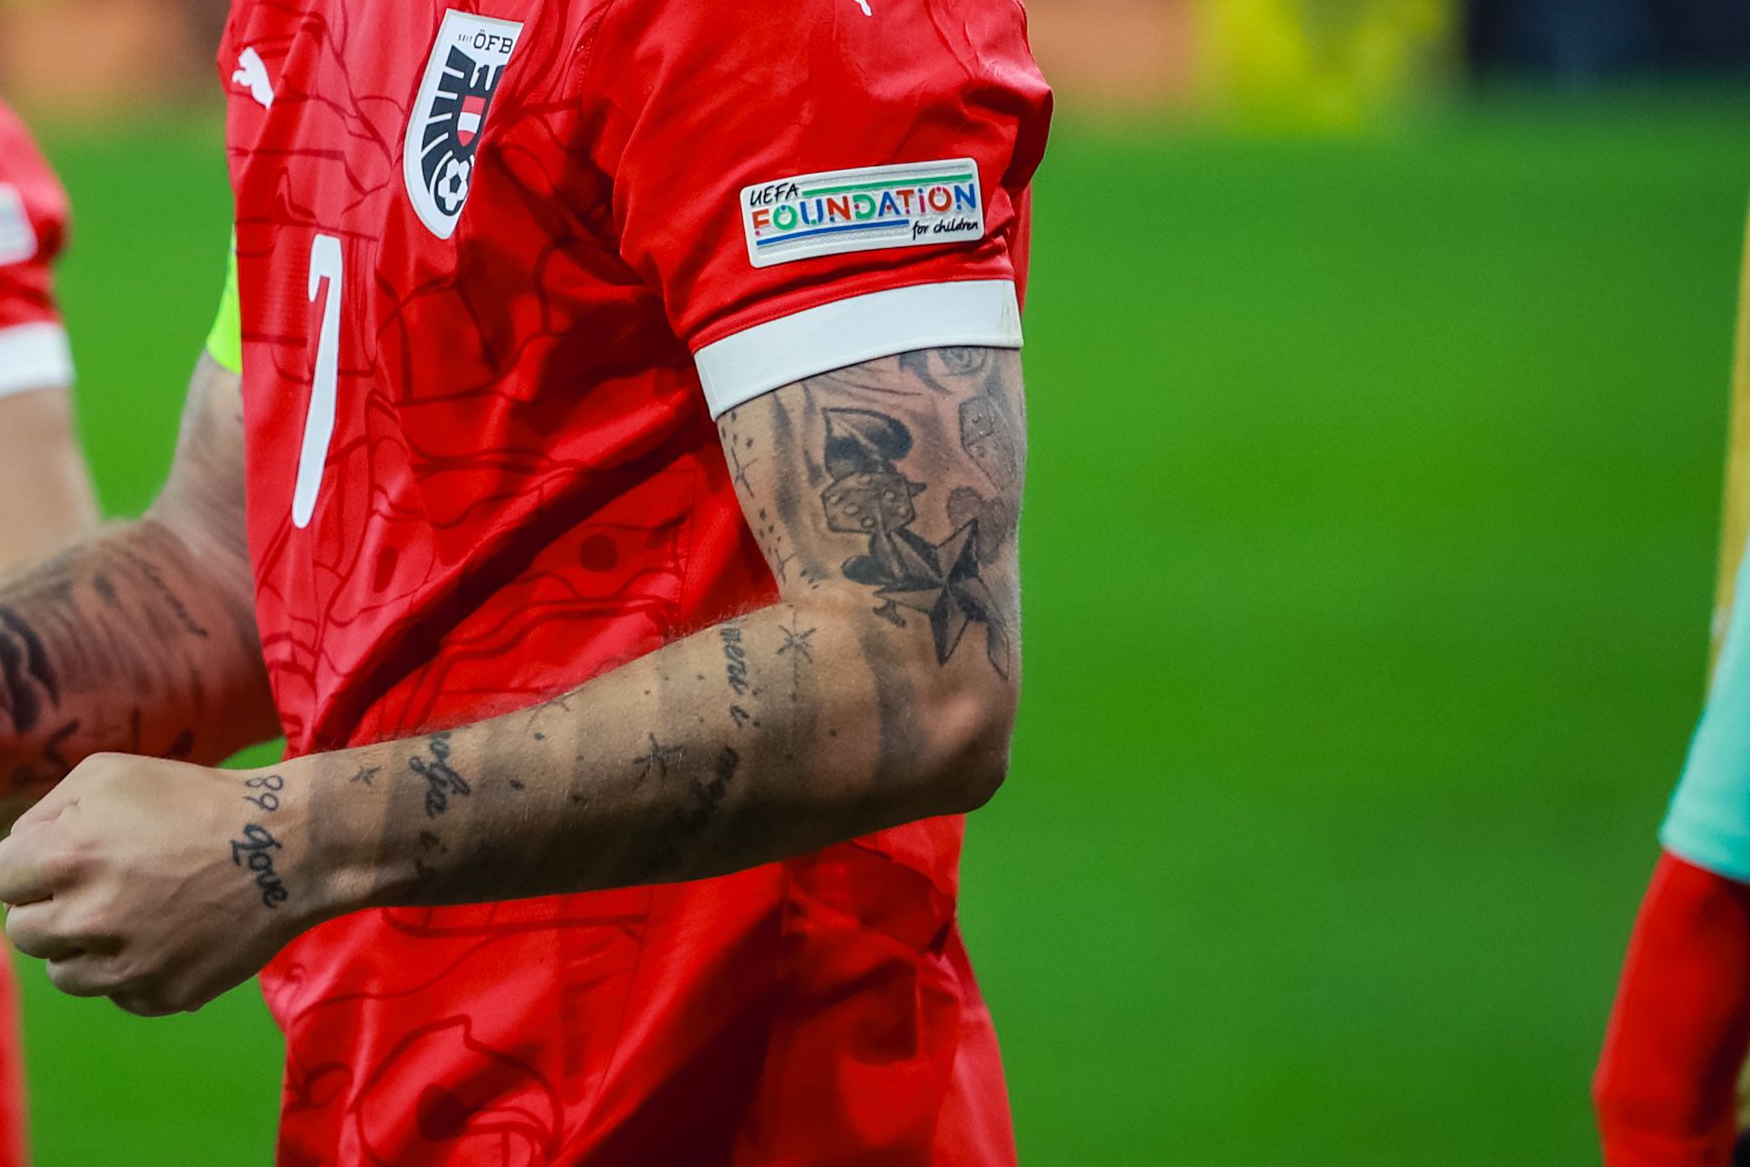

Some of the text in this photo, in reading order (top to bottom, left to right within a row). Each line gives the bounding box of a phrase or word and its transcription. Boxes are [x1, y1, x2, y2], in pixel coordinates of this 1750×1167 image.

[473, 28, 514, 54] ÖFB
[750, 182, 800, 207] UEFA
[752, 183, 977, 236] FOUNDATION
[912, 219, 978, 240] for children
[291, 233, 344, 529] 7
[242, 774, 284, 812] 89
